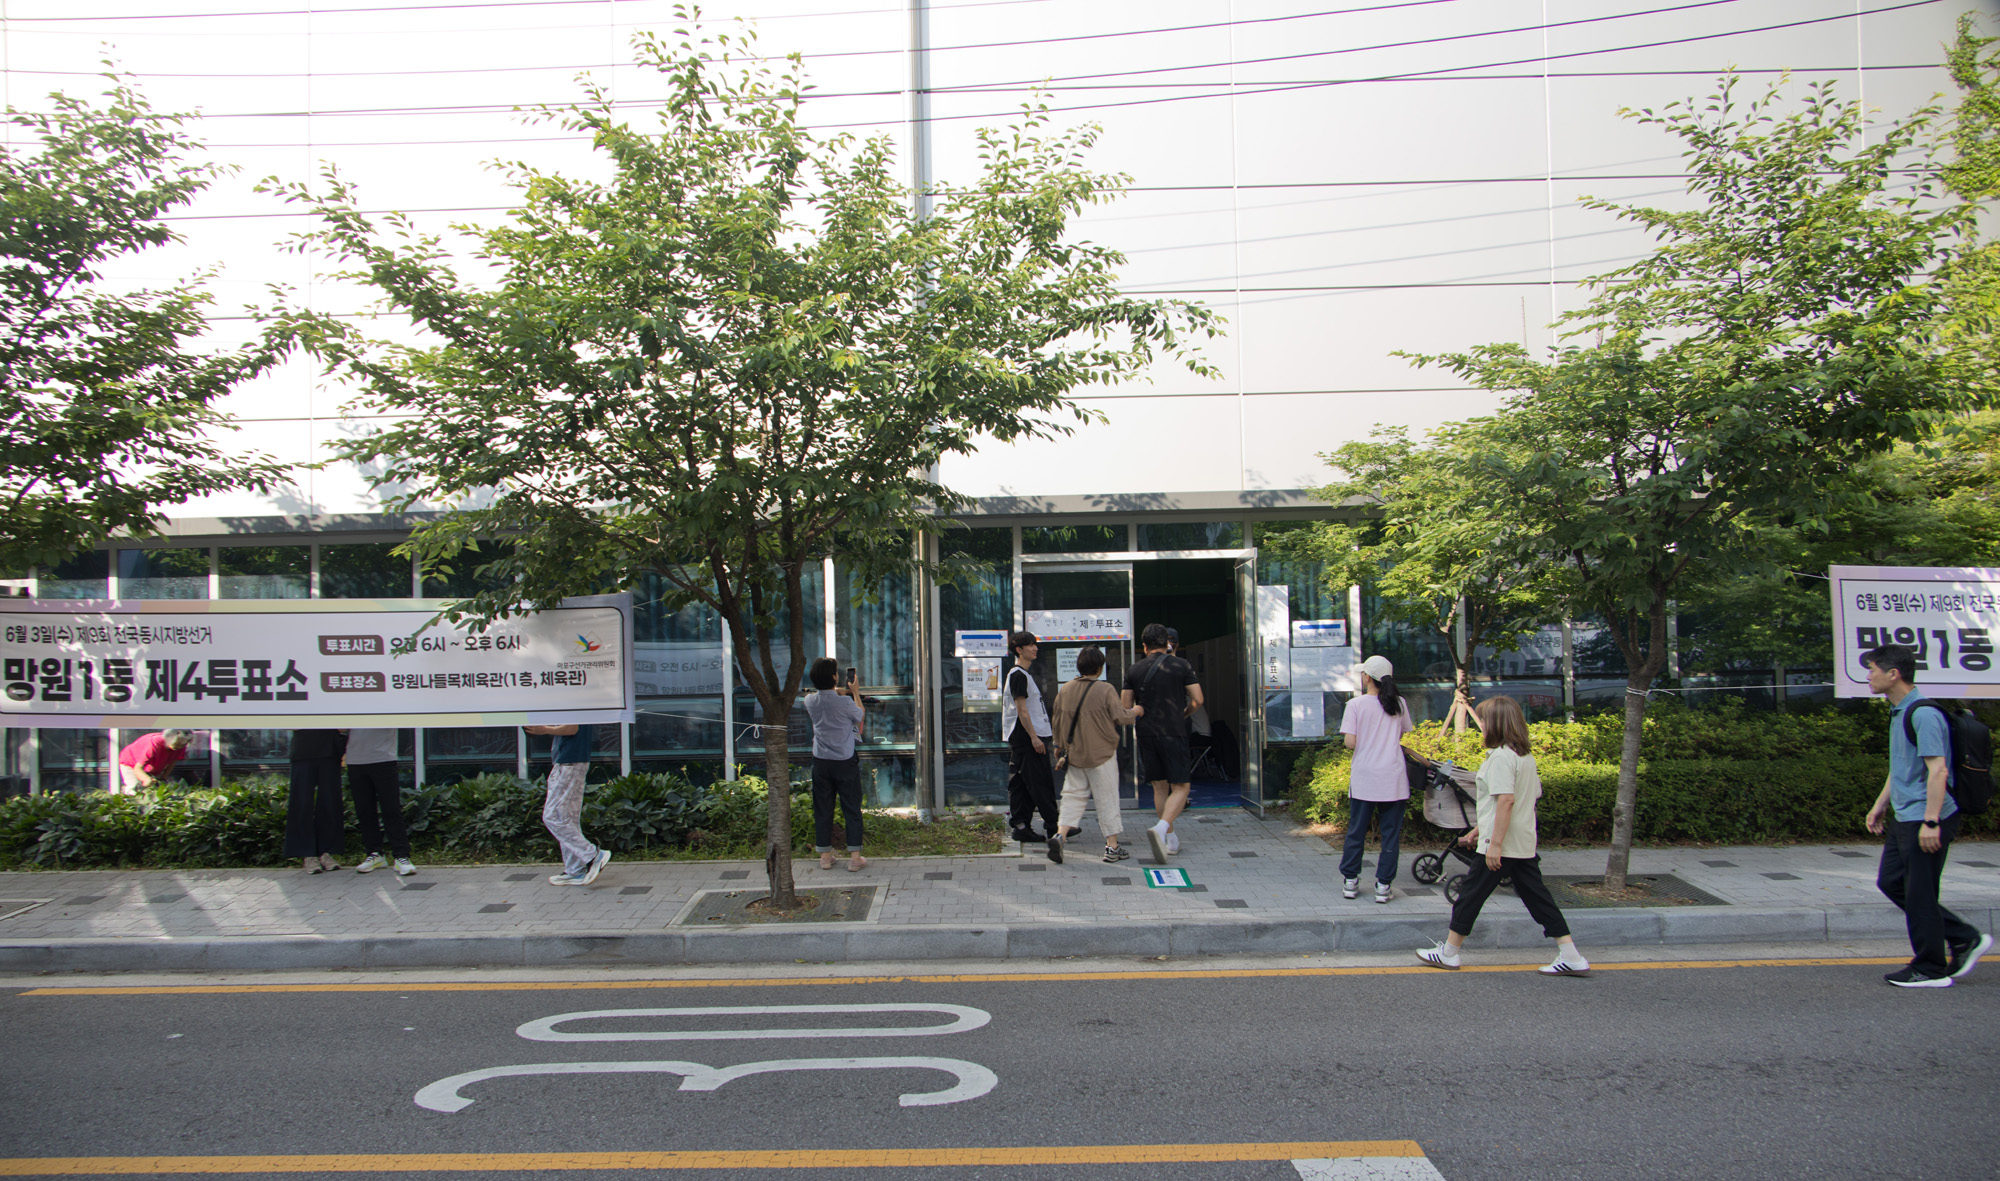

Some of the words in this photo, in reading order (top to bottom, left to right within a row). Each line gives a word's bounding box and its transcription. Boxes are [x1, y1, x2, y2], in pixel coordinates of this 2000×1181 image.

[1856, 593, 1878, 611] 6월
[1882, 593, 1926, 612] 3일(수)
[1929, 594, 1966, 612] 제9회
[1969, 594, 2000, 613] 전국
[6, 625, 27, 643] 6월
[31, 625, 74, 644] 3일(수)
[76, 625, 112, 644] 제9회
[114, 625, 213, 644] 전국동시지방선거
[421, 637, 446, 652] 6시
[464, 635, 492, 651] 오후
[496, 635, 520, 650] 6시
[326, 638, 376, 652] 투표시간
[557, 660, 616, 670] 마포구선거관리위원회
[4, 658, 134, 702] 망원1동
[145, 659, 308, 703] 제4투표소
[328, 674, 377, 689] 투표장소
[392, 671, 538, 690] 망원나들목체육관(1층,
[540, 669, 588, 687] 체육관)
[414, 1003, 998, 1112] 30
